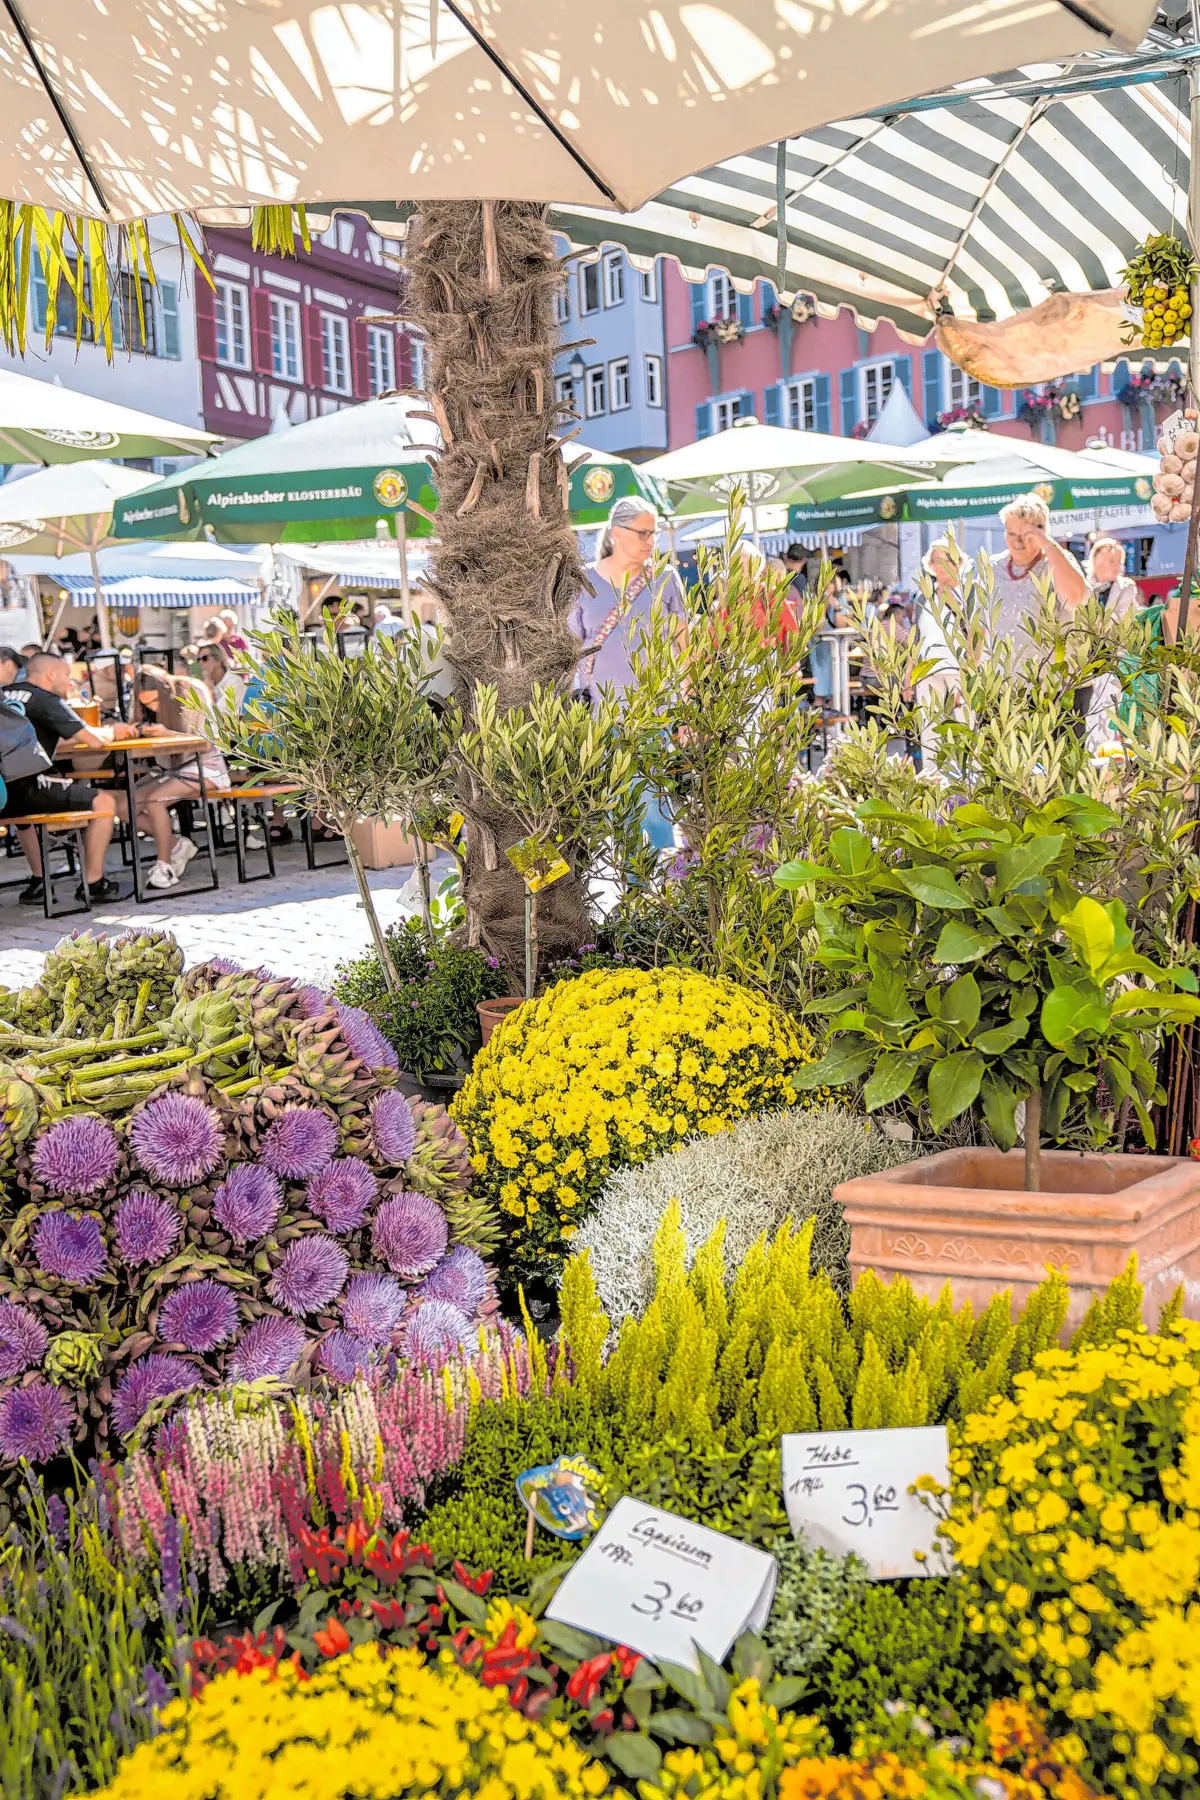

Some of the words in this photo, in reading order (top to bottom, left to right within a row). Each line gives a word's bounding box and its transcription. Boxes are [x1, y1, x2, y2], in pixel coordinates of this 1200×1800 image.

[207, 490, 286, 508] Alpirsbacher
[287, 486, 363, 502] KLOSTERBRÄU
[806, 1444, 853, 1463] Hebe
[631, 1516, 713, 1564] Capsicum
